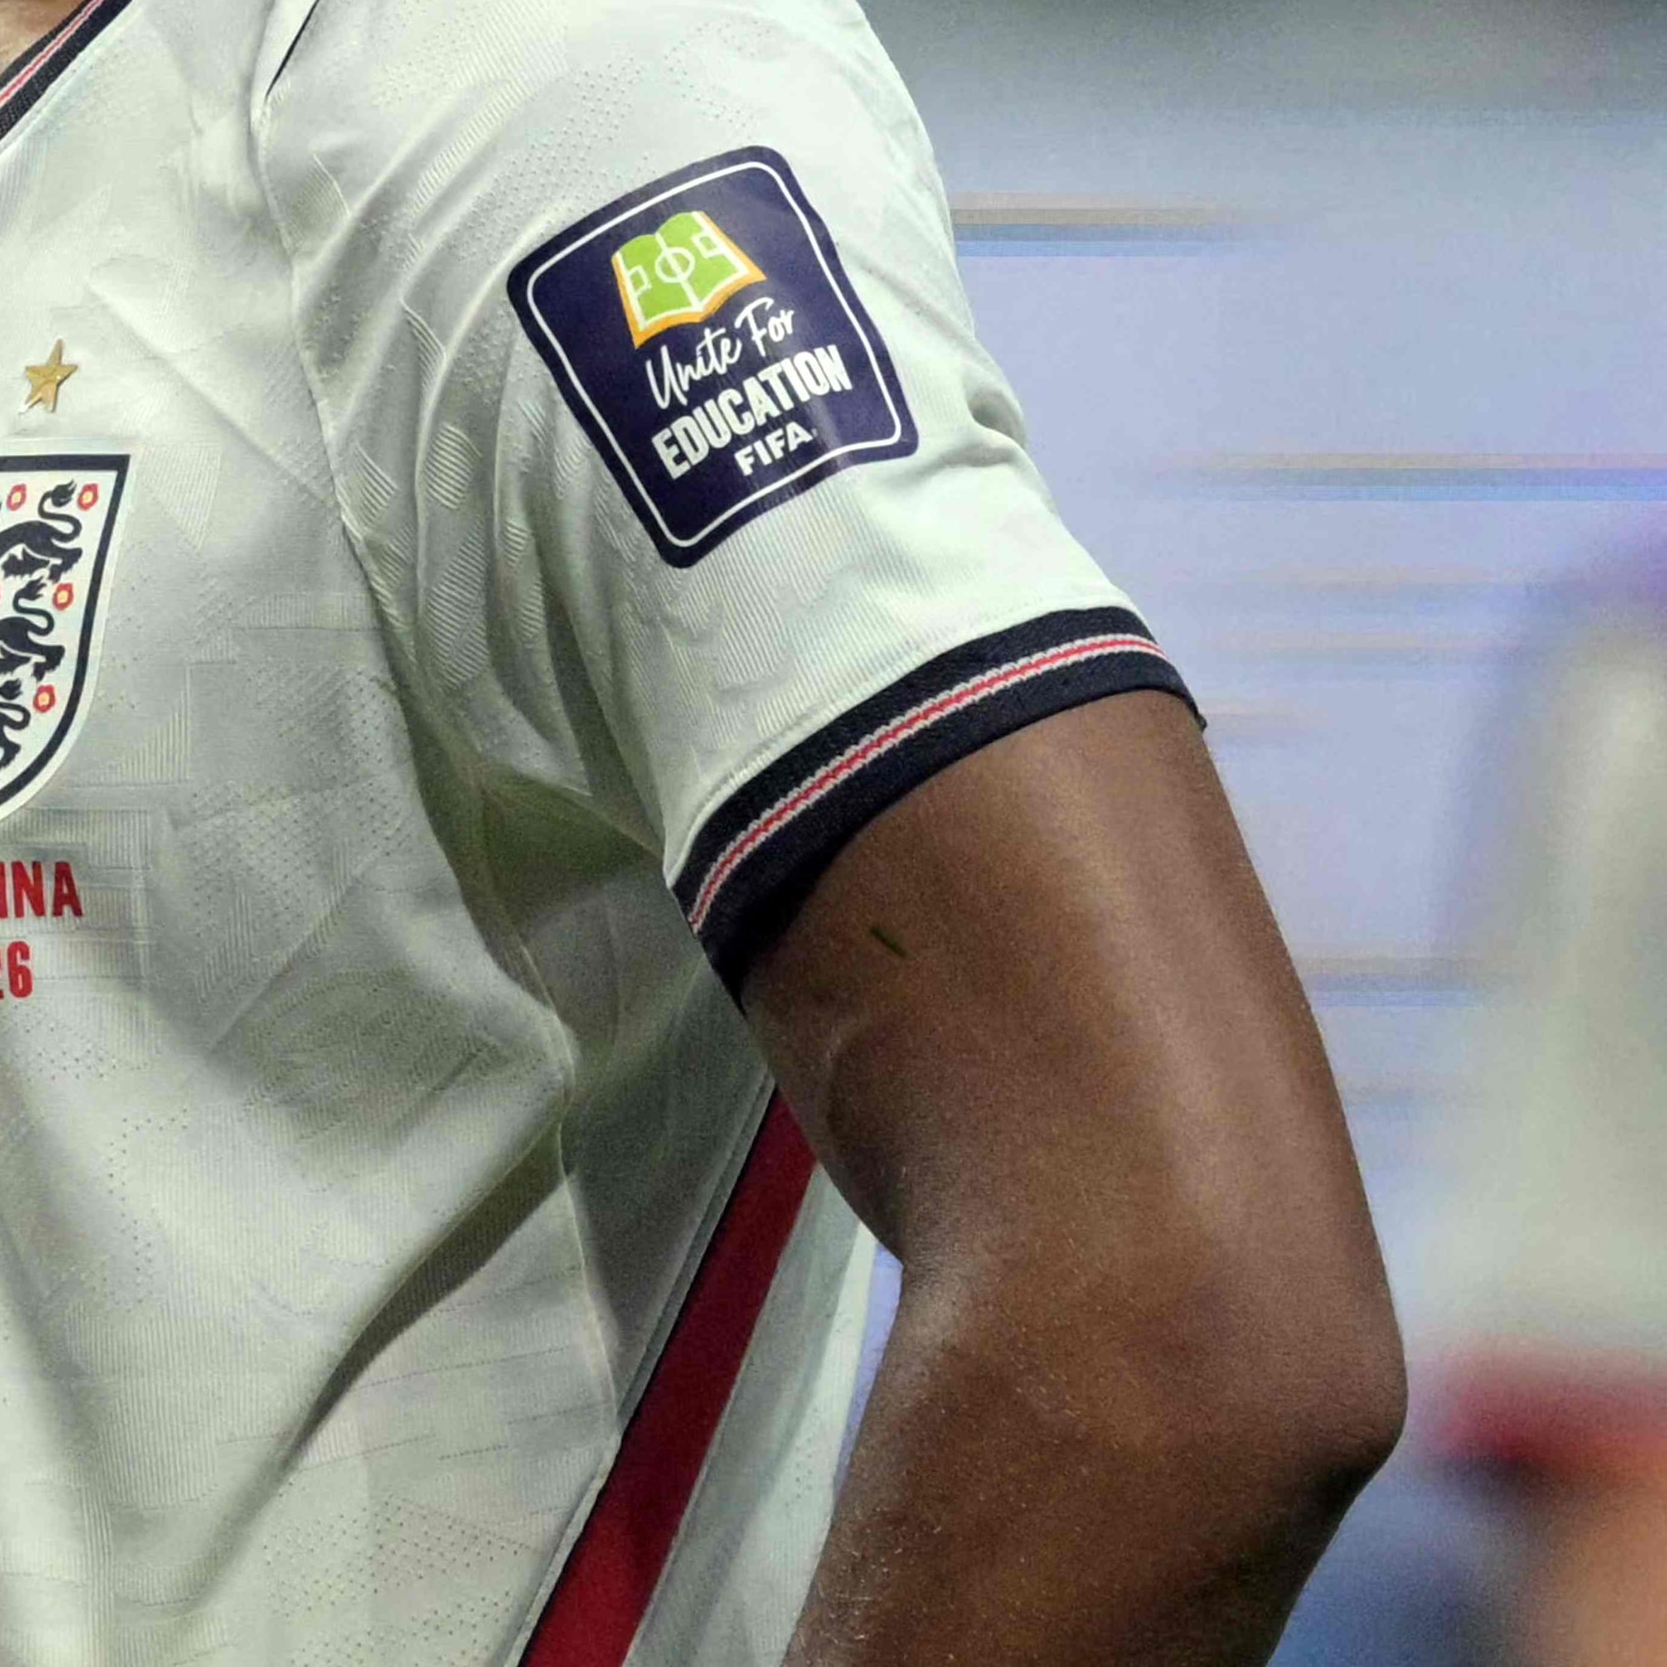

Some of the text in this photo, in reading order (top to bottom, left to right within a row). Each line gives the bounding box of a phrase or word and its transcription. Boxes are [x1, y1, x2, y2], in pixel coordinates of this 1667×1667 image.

[646, 297, 796, 410] Unite For
[651, 344, 854, 481] EDUCATION
[733, 421, 814, 477] FIFA
